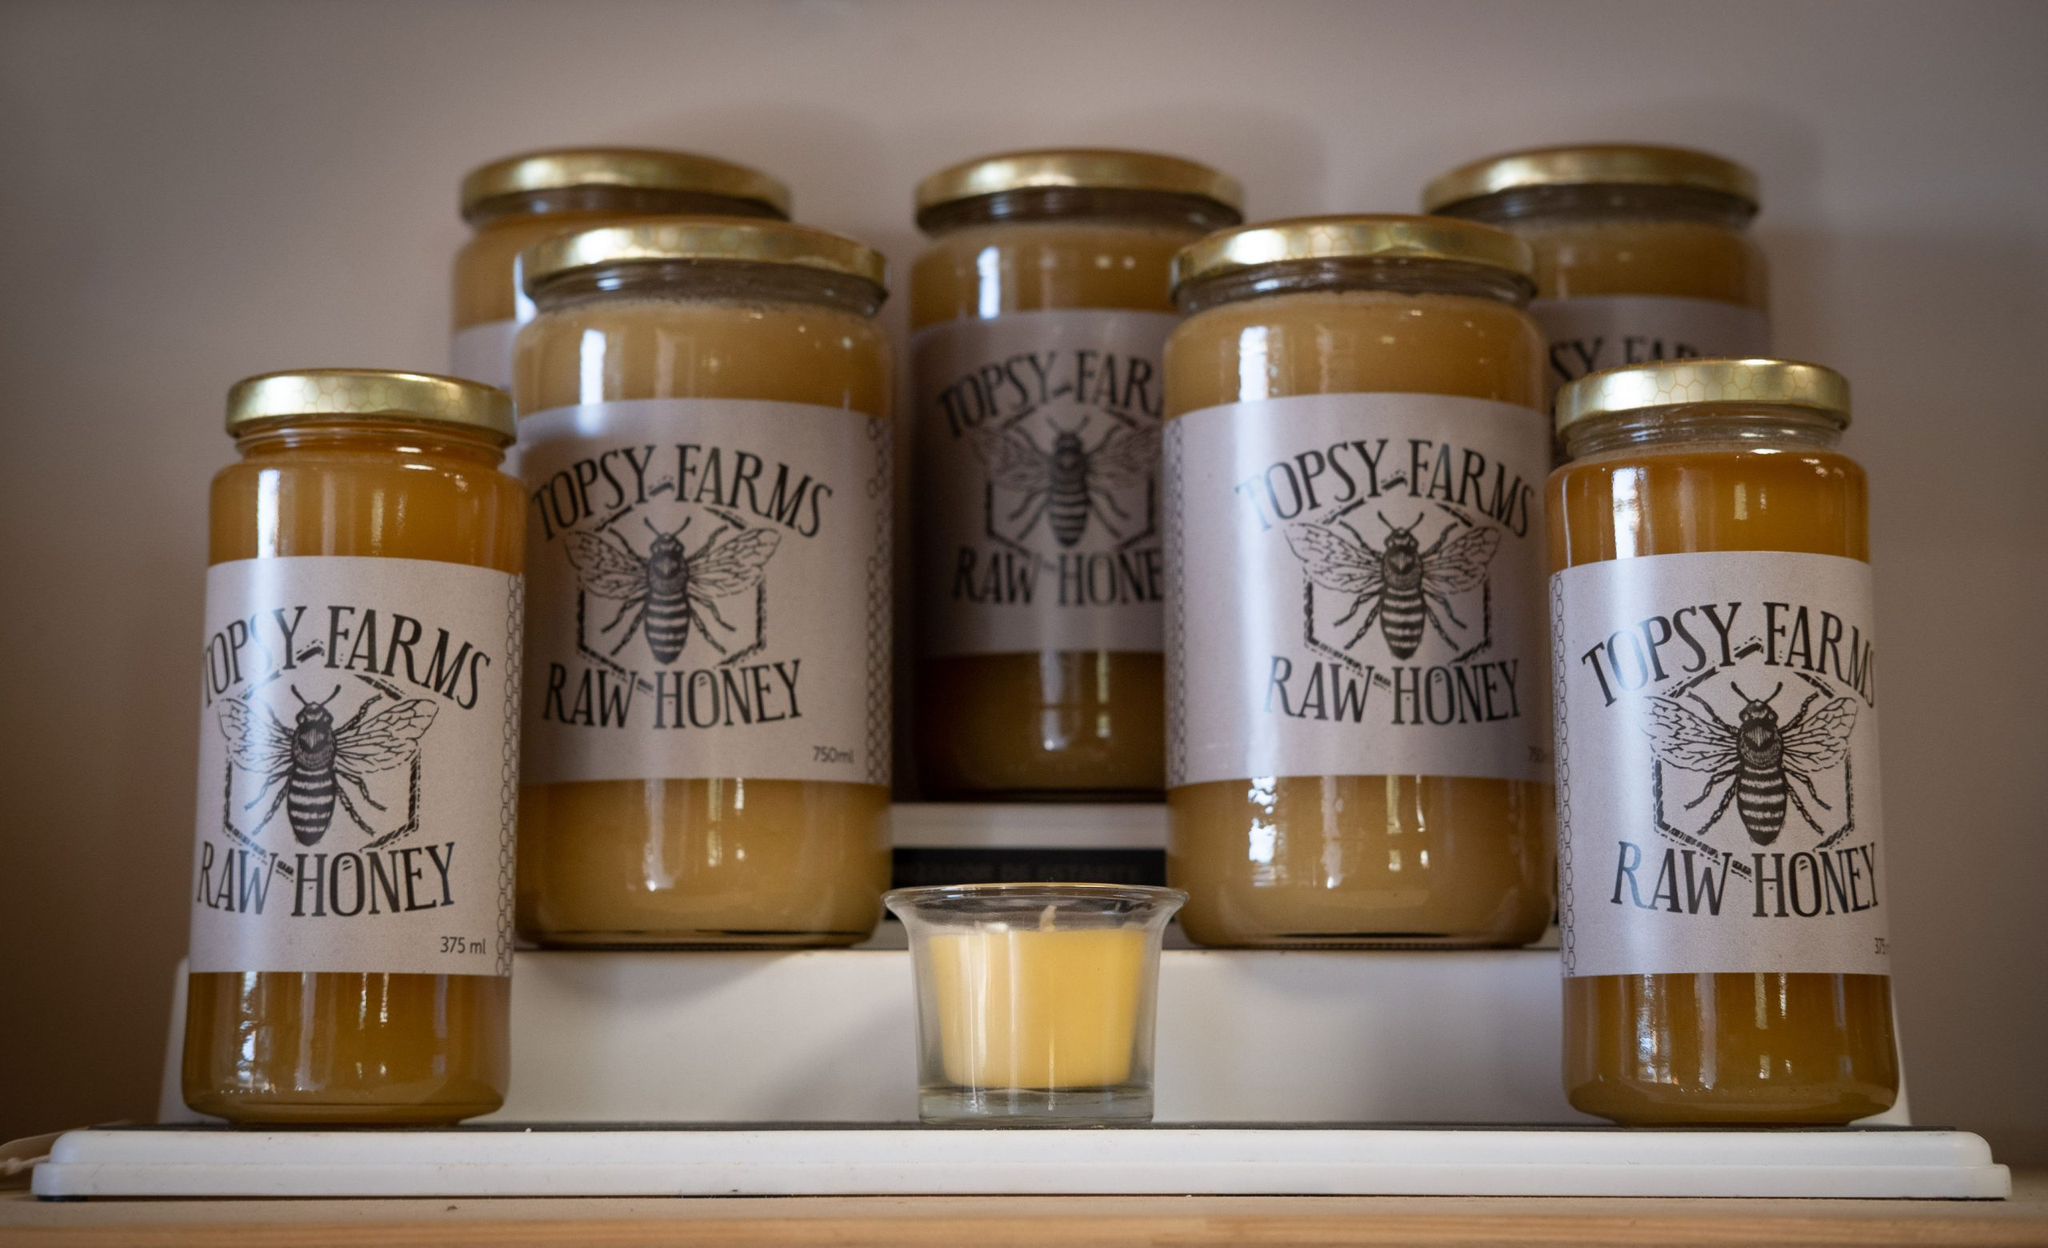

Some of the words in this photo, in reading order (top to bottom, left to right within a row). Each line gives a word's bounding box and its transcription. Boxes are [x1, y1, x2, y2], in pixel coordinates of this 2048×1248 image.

[938, 351, 1055, 439] TOPSY
[1076, 350, 1163, 420] FAR
[532, 444, 655, 541] TOPSY
[675, 443, 833, 538] FARMS
[1234, 438, 1388, 532] TOPSY
[1407, 438, 1535, 538] FARMS
[952, 547, 1041, 604] RAW
[1058, 547, 1163, 606] HONE
[324, 604, 491, 710] FARMS
[1263, 655, 1374, 724] RAW
[1391, 659, 1522, 726] HONEY
[1581, 602, 1741, 708] TOPSY
[1762, 601, 1876, 708] FARMS
[543, 661, 637, 729] RAW
[652, 658, 802, 730] HONEY
[812, 745, 855, 764] 750ml
[197, 841, 278, 916] RAW
[291, 842, 455, 918] HONEY
[1610, 841, 1731, 916] RAW
[1752, 842, 1879, 918] HONEY
[440, 936, 466, 954] 375
[469, 938, 487, 955] ml
